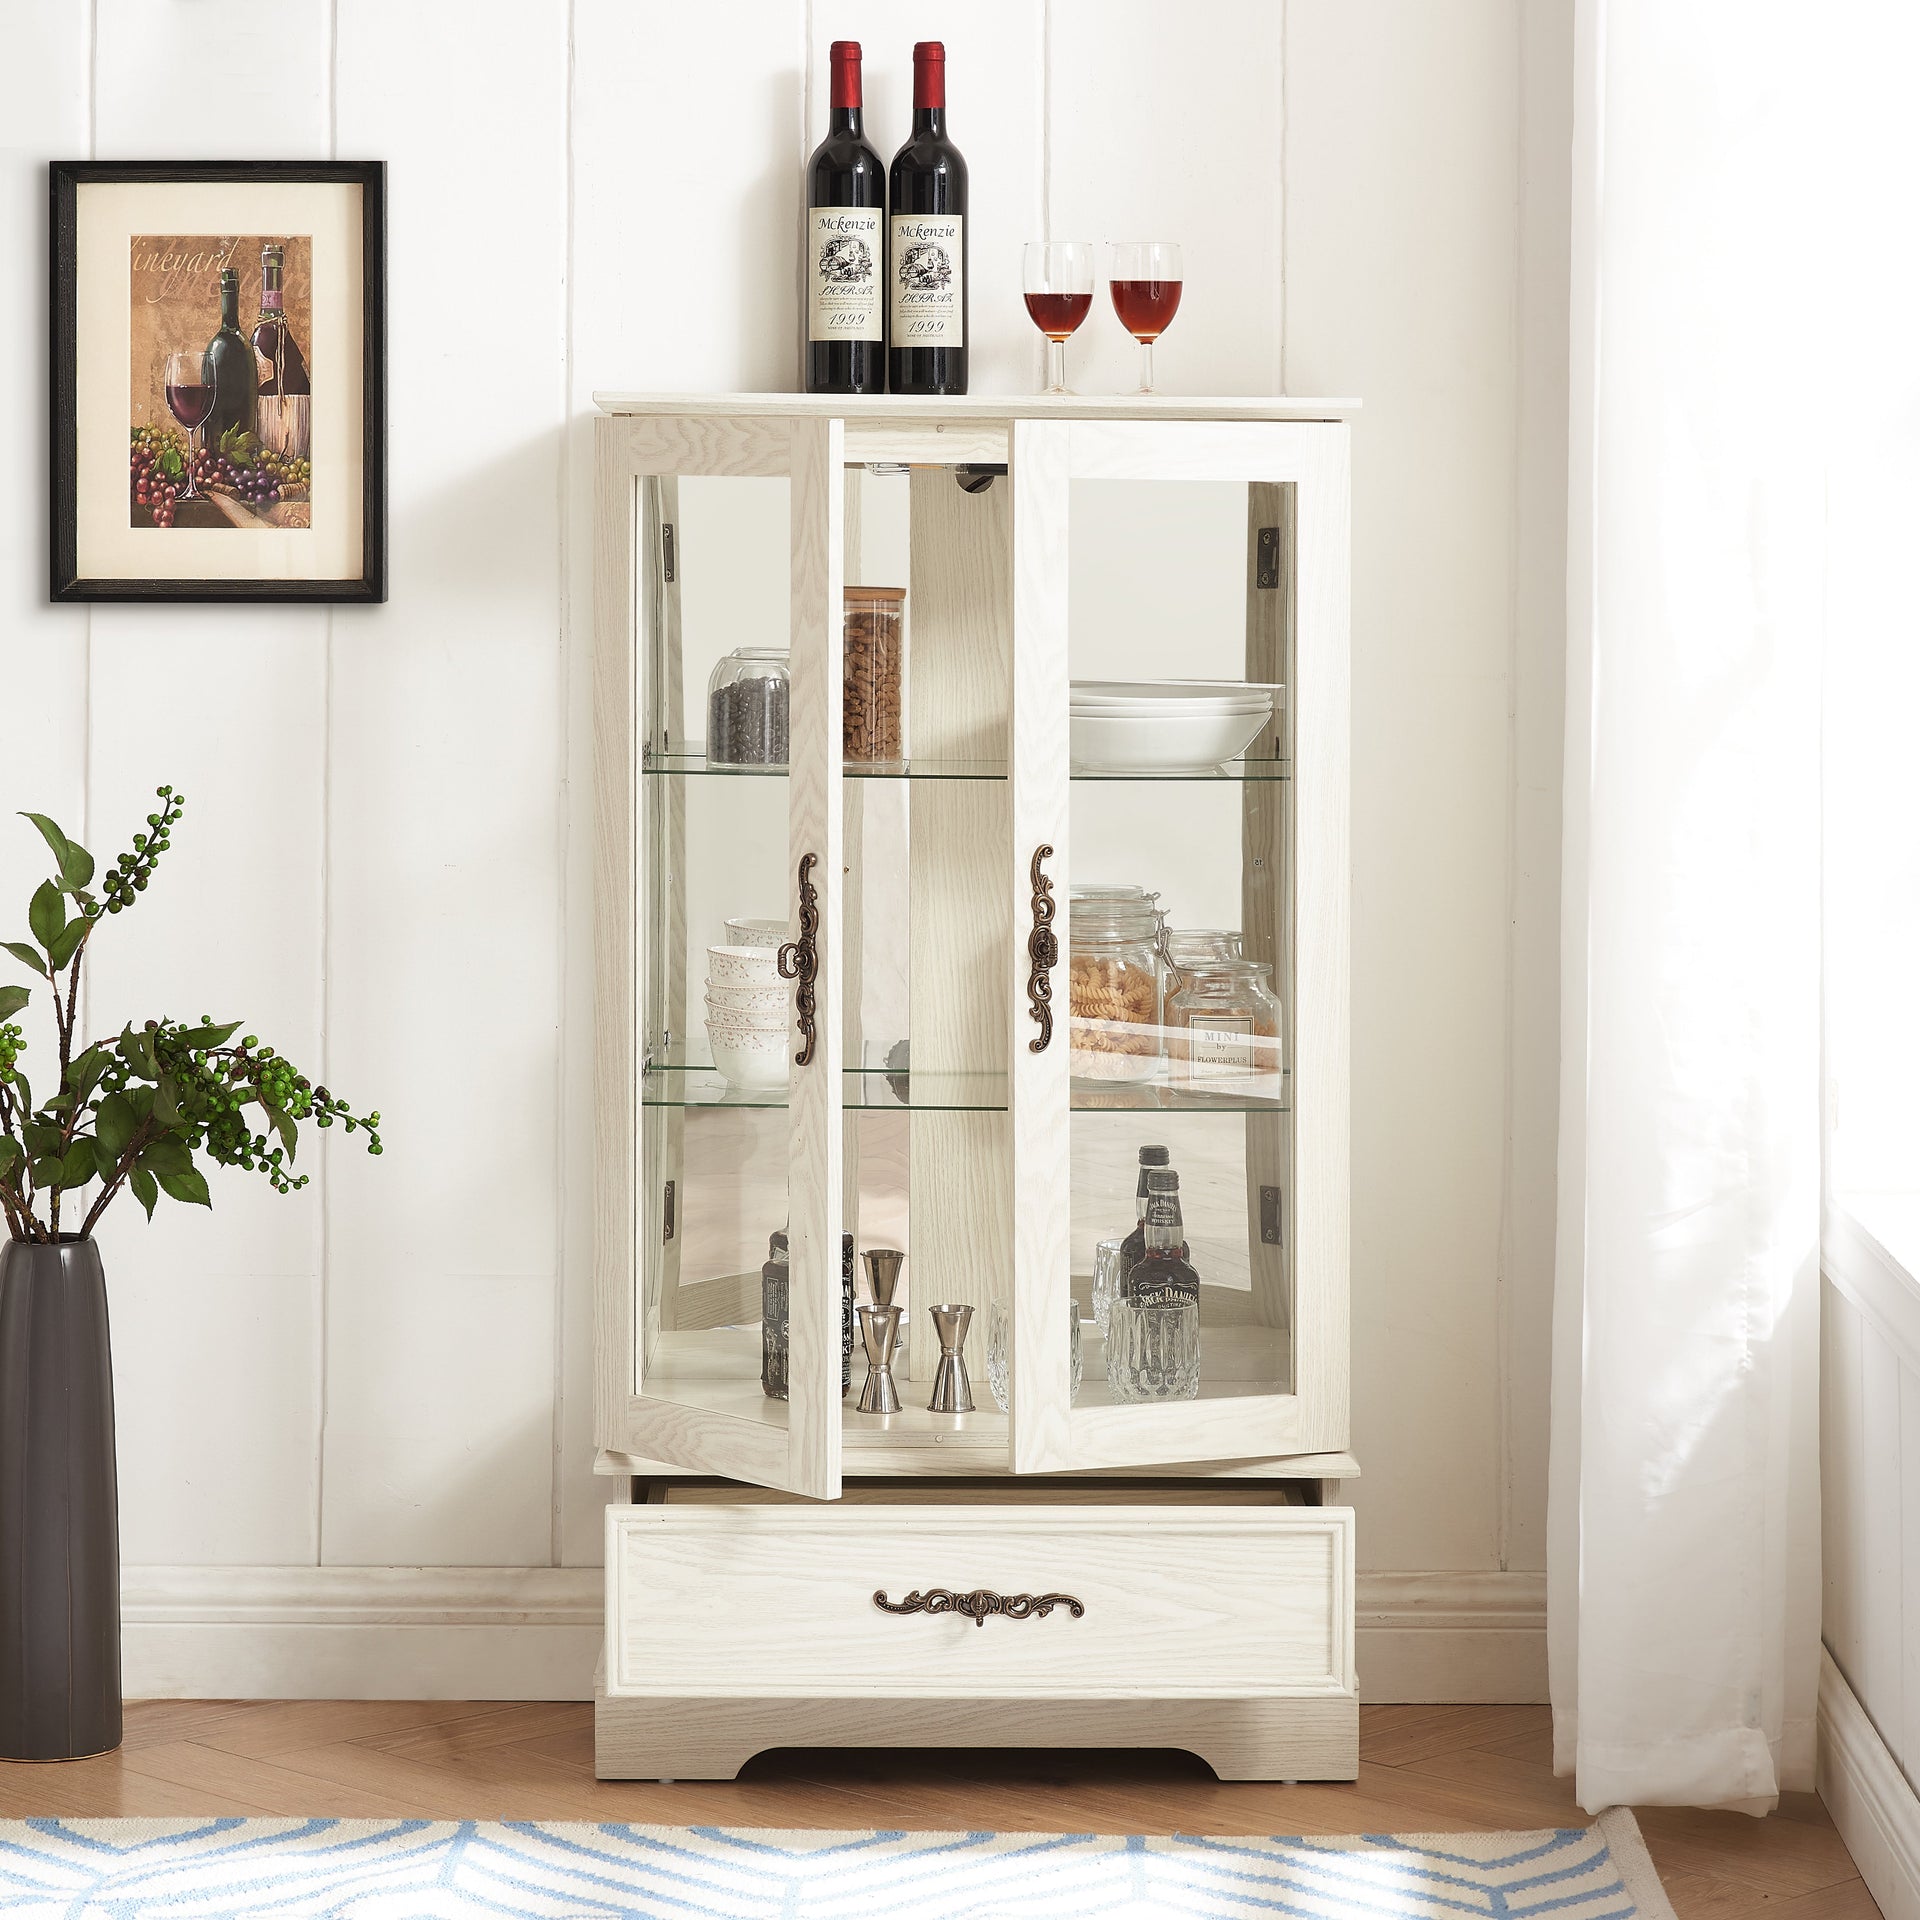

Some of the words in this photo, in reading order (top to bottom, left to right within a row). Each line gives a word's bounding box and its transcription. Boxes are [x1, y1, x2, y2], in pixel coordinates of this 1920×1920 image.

[131, 236, 241, 303] ineyard
[818, 285, 874, 296] SHIRAZ
[898, 293, 954, 303] SHIRAZ
[829, 313, 865, 325] 1999
[908, 321, 944, 332] 1999
[1204, 1032, 1240, 1042] MINI
[1216, 1043, 1227, 1052] by
[1197, 1056, 1248, 1064] FLOWERPLUS
